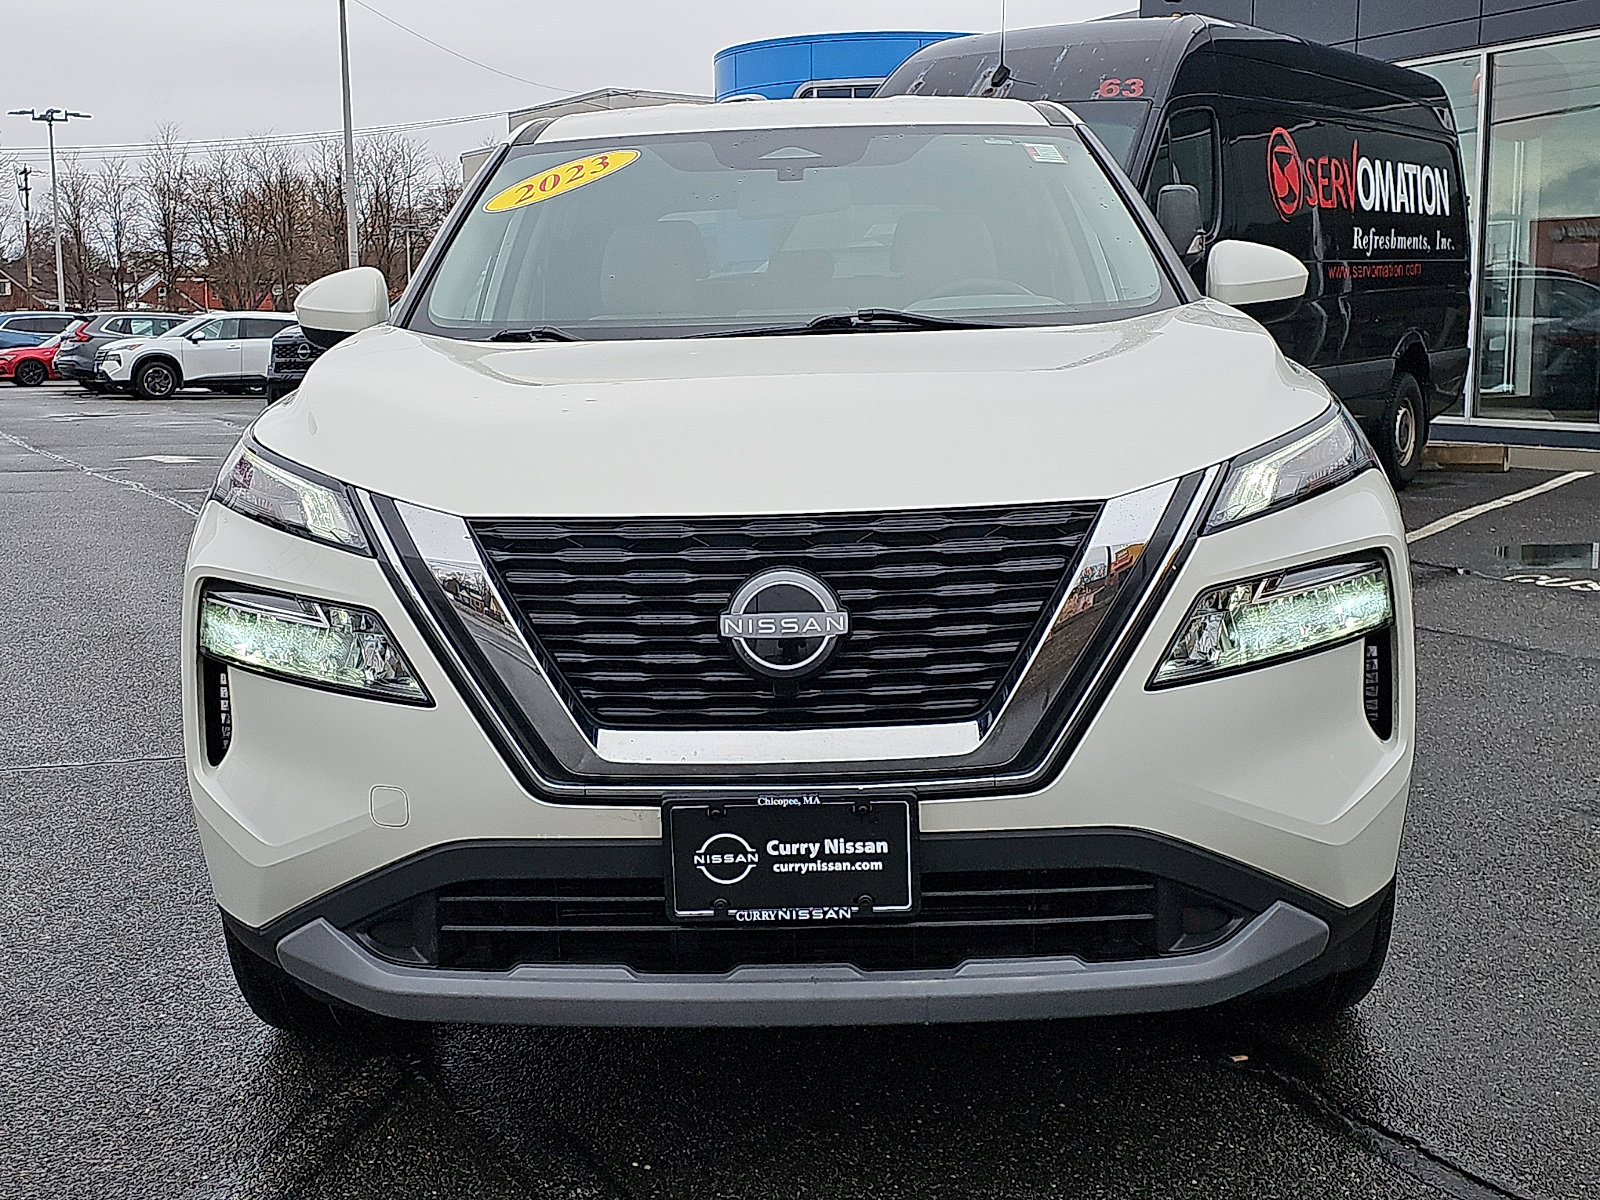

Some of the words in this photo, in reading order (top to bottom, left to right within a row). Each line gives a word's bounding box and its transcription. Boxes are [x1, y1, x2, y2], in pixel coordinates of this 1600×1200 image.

[1099, 78, 1144, 98] 63
[514, 155, 610, 205] 2023
[1305, 138, 1451, 217] SERVOMATION
[1352, 227, 1431, 257] Refreshments,
[1436, 230, 1456, 251] Inc.
[1328, 262, 1422, 279] www.servomation.com
[724, 615, 845, 634] NISSAN
[757, 796, 801, 807] Chicopee,
[803, 796, 821, 805] MA
[766, 839, 820, 858] Curry
[824, 838, 889, 855] Nissan
[693, 853, 759, 865] NISSAN
[772, 860, 883, 874] currynissan.com
